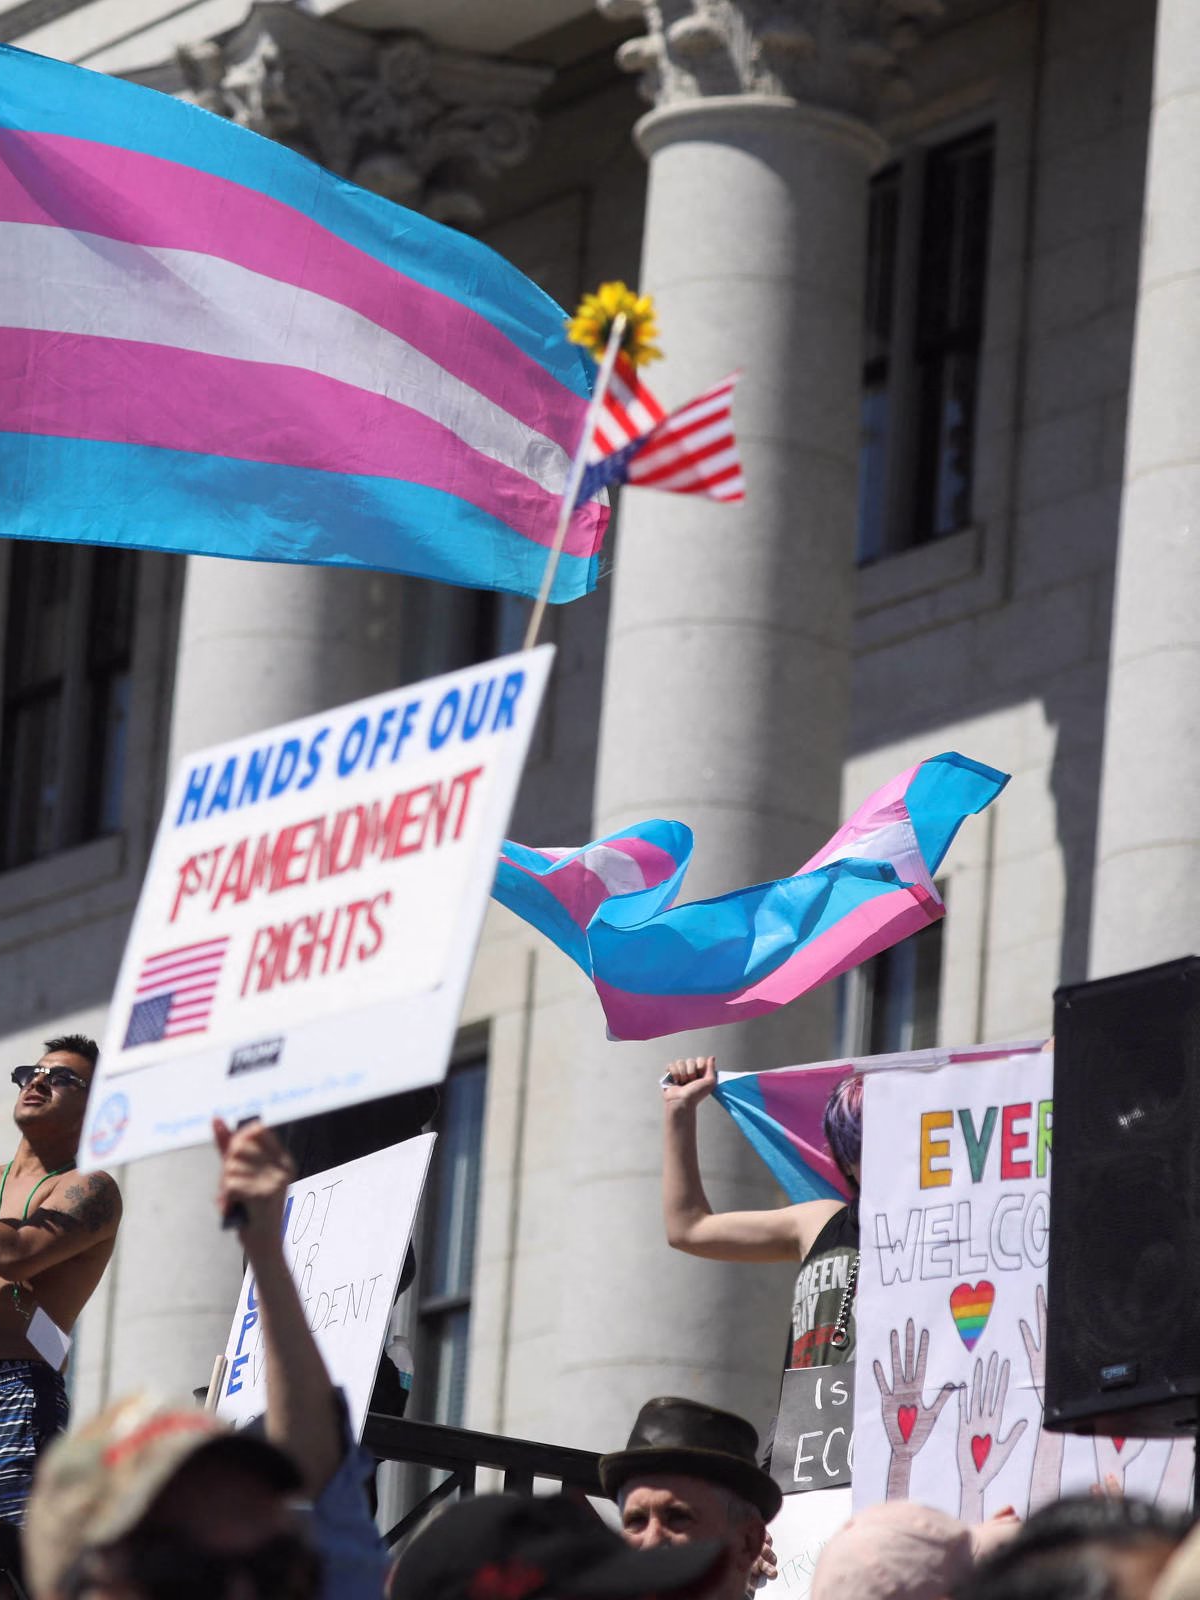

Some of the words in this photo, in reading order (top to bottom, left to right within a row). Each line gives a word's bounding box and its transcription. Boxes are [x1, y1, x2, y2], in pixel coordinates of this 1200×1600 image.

[176, 727, 332, 827] HANDS
[335, 700, 422, 779] OFF
[427, 669, 526, 752] OUR
[210, 765, 485, 913] AMENDMENT
[240, 889, 393, 999] RIGHTS
[875, 1190, 1051, 1287] WELCO
